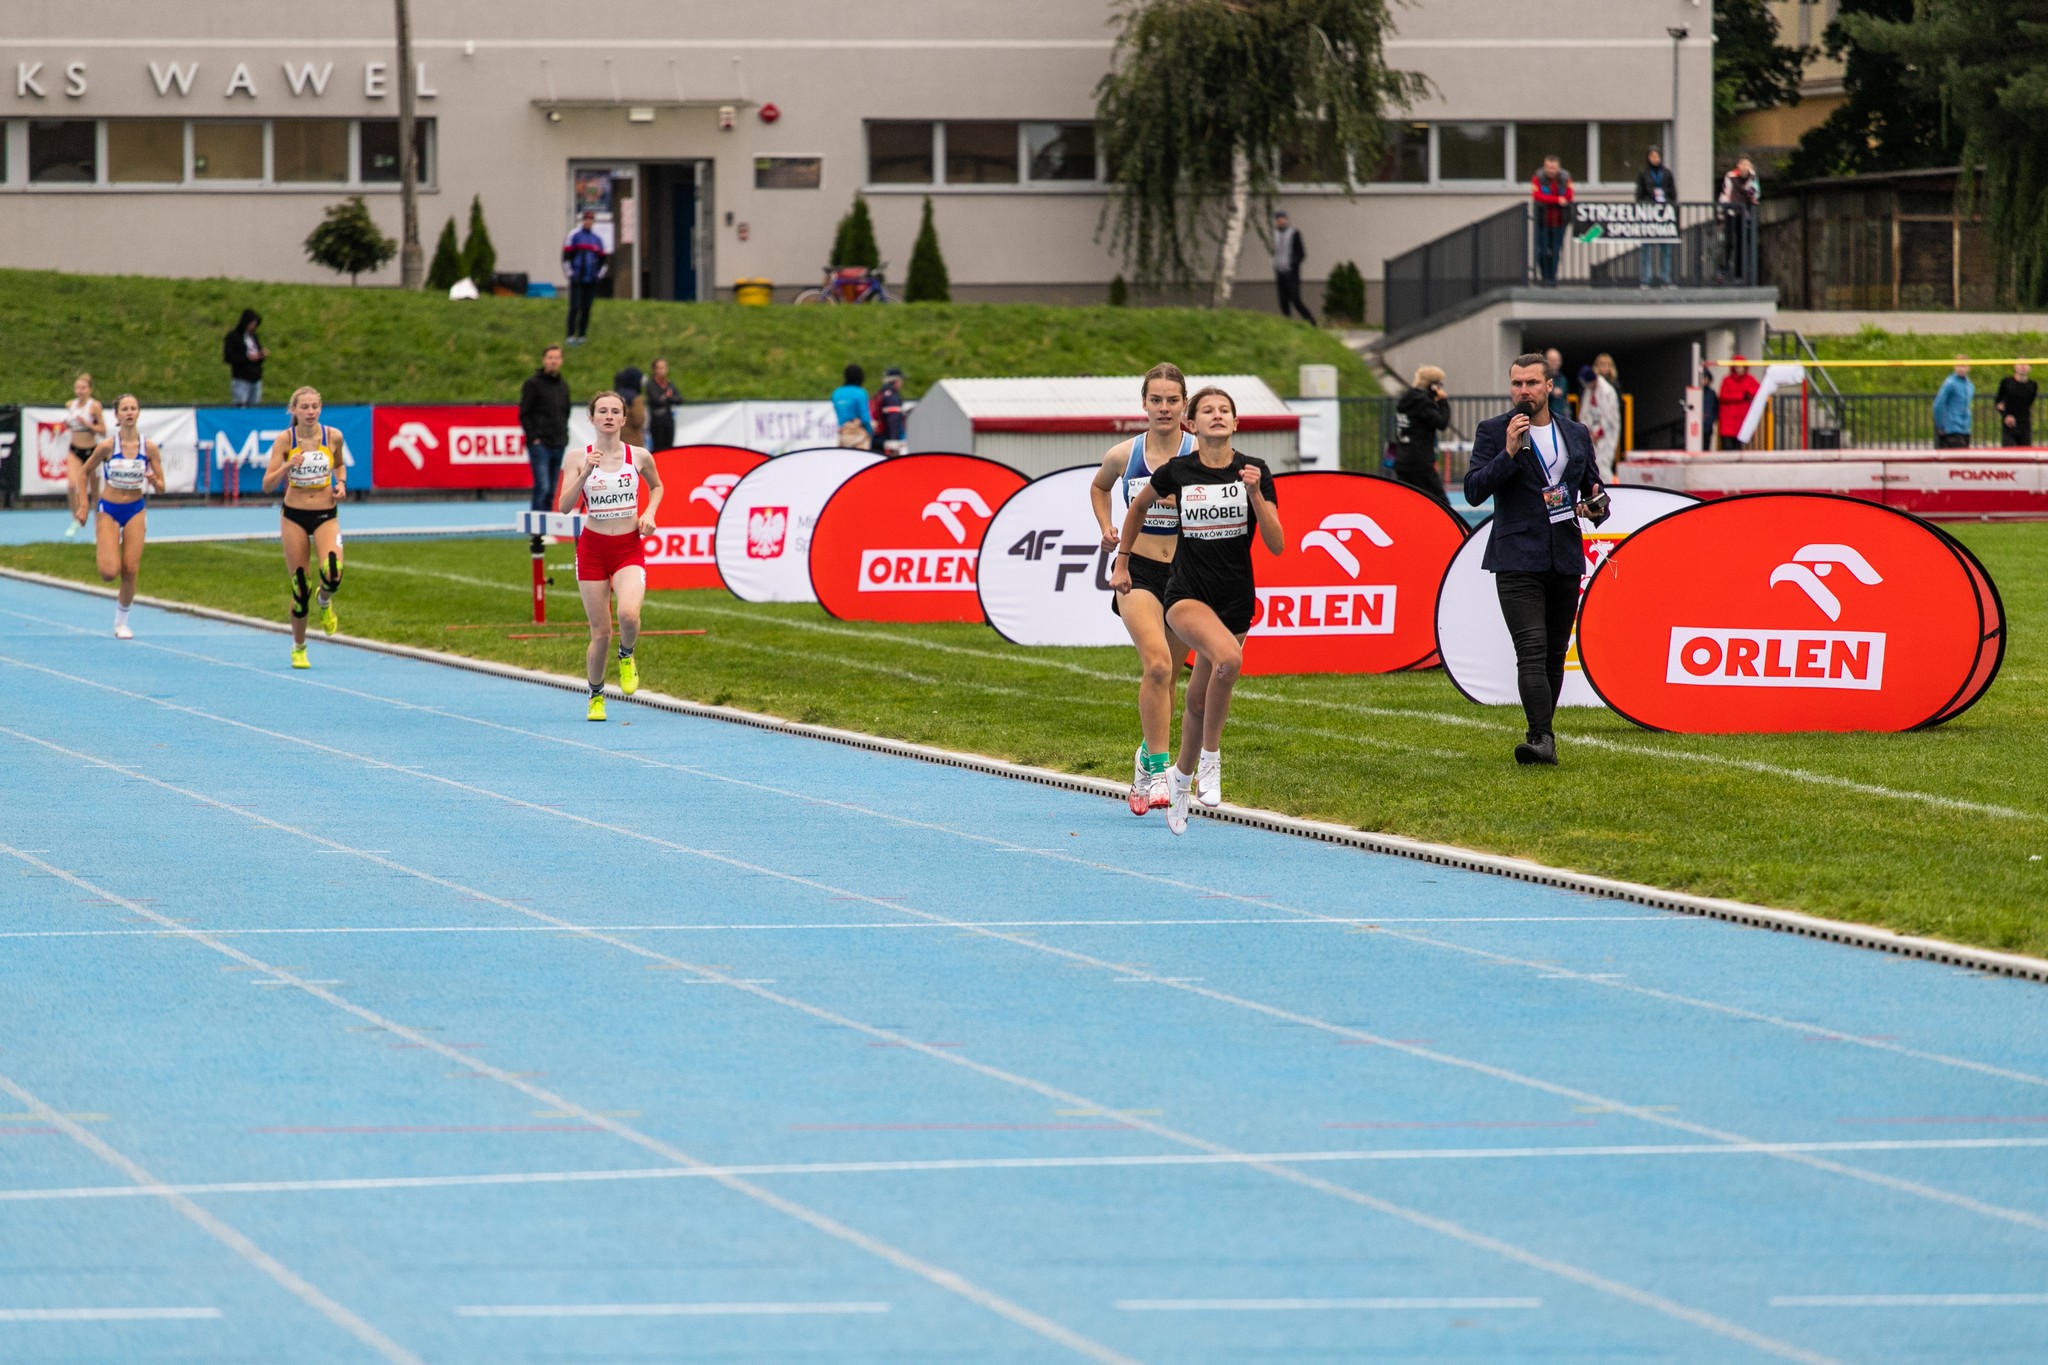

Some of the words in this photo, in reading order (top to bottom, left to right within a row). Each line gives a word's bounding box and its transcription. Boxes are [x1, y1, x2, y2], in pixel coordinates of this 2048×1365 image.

[17, 62, 88, 98] KS
[148, 61, 439, 98] WAWEL
[1576, 203, 1677, 222] STRZELNICA
[312, 453, 324, 461] 22
[1948, 469, 2017, 482] POLANIK
[618, 478, 631, 488] 13
[590, 492, 635, 505] MAGRYTA
[1221, 485, 1238, 499] 10
[595, 511, 620, 519] KRAKÓW
[1185, 505, 1244, 521] WRÓBEL
[1190, 530, 1223, 539] KRAKÓW
[1224, 528, 1242, 537] 2022
[1008, 530, 1064, 561] 4F
[868, 556, 976, 584] ORLEN
[1680, 636, 1870, 680] ORLEN
